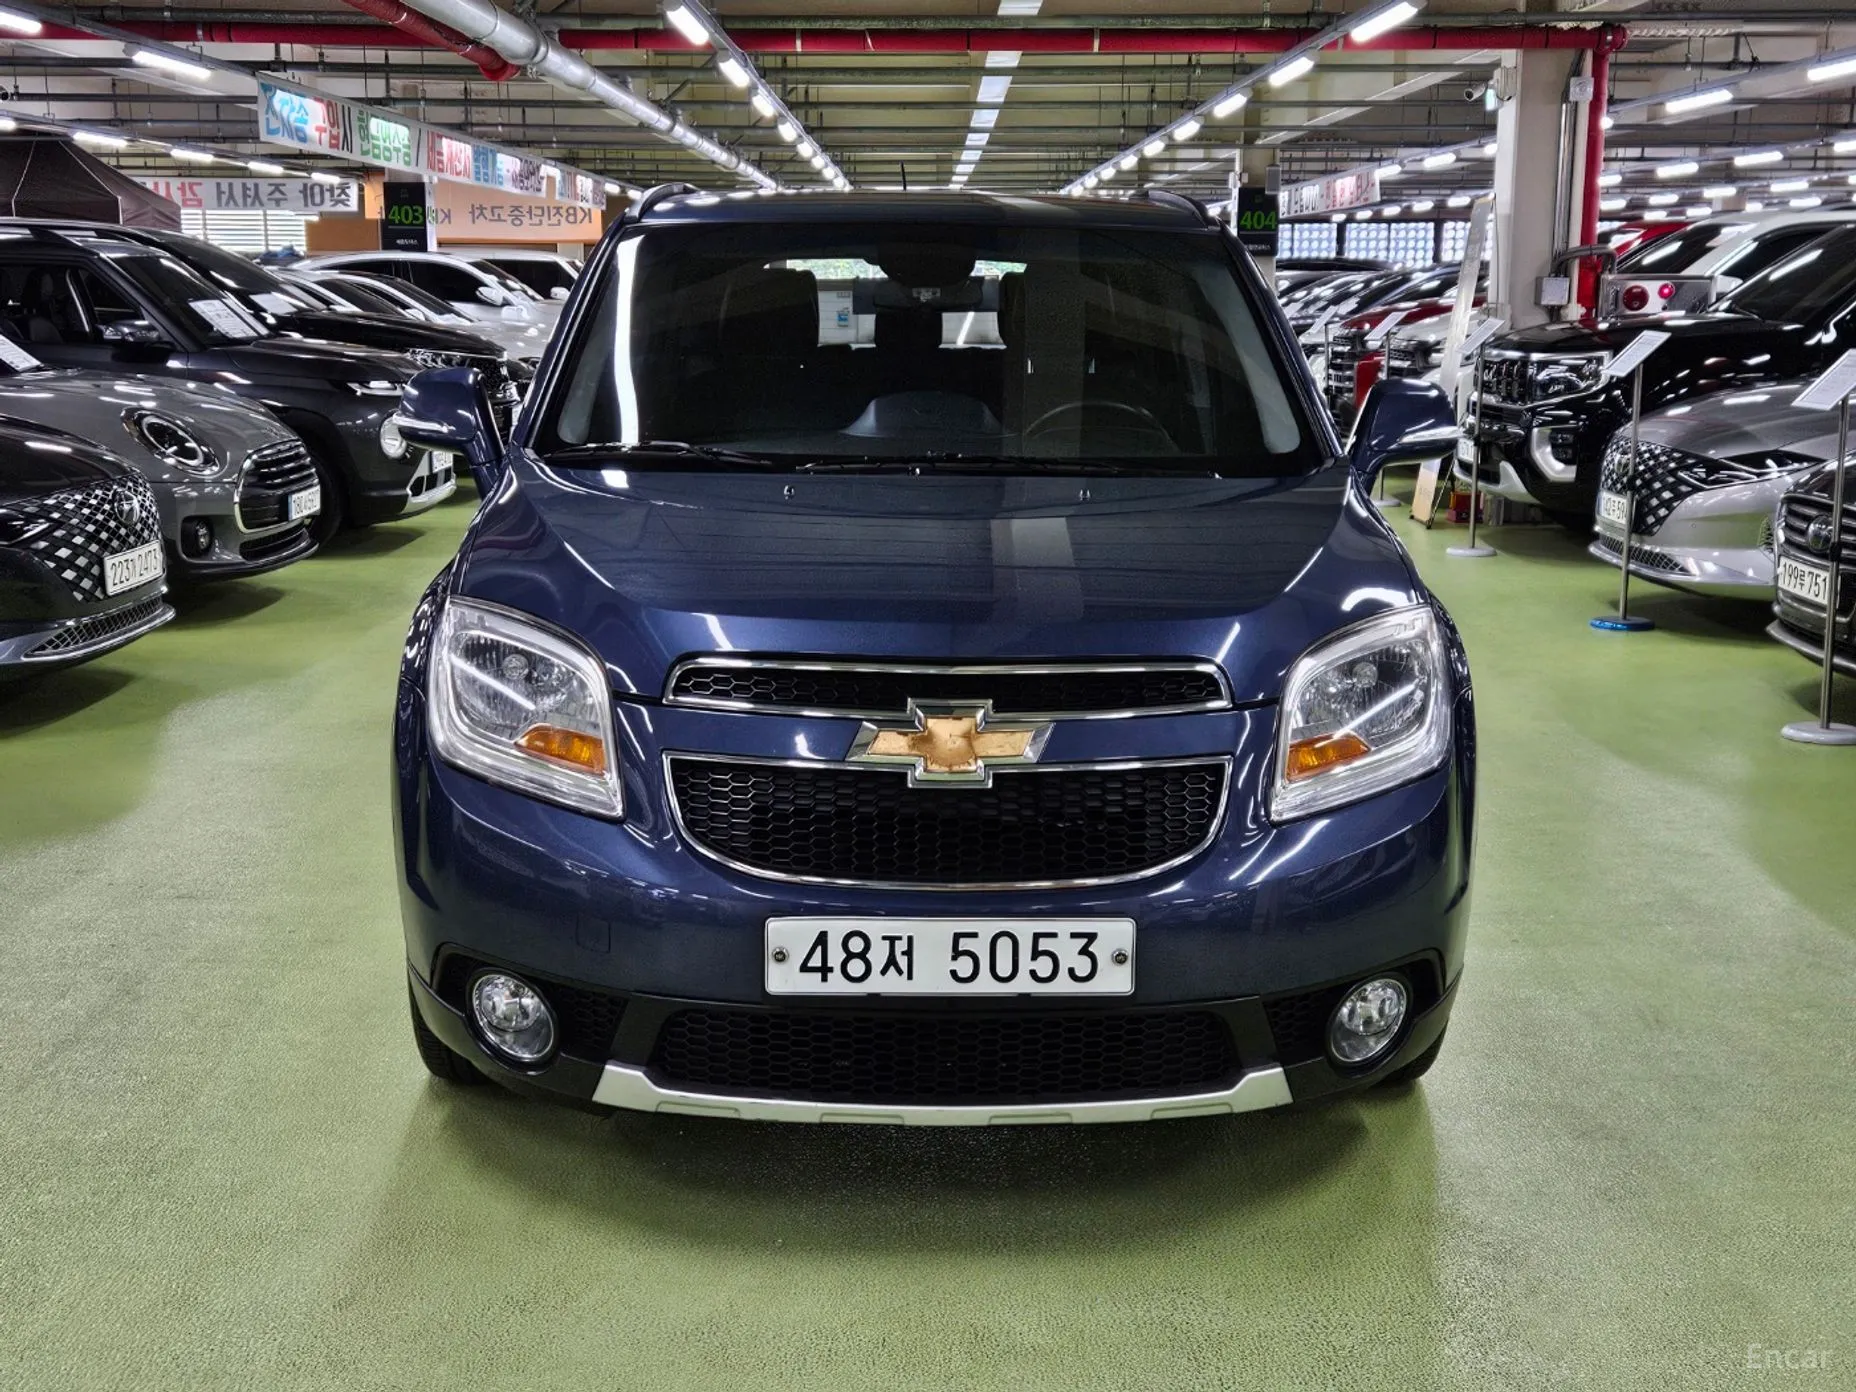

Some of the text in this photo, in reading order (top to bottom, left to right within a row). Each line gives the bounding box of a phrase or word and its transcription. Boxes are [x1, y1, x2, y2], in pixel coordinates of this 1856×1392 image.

[388, 204, 425, 225] 403
[1240, 210, 1277, 230] 404
[138, 547, 158, 577] 2473
[1783, 562, 1828, 601] 199루 751
[799, 929, 1099, 984] 48저 5053
